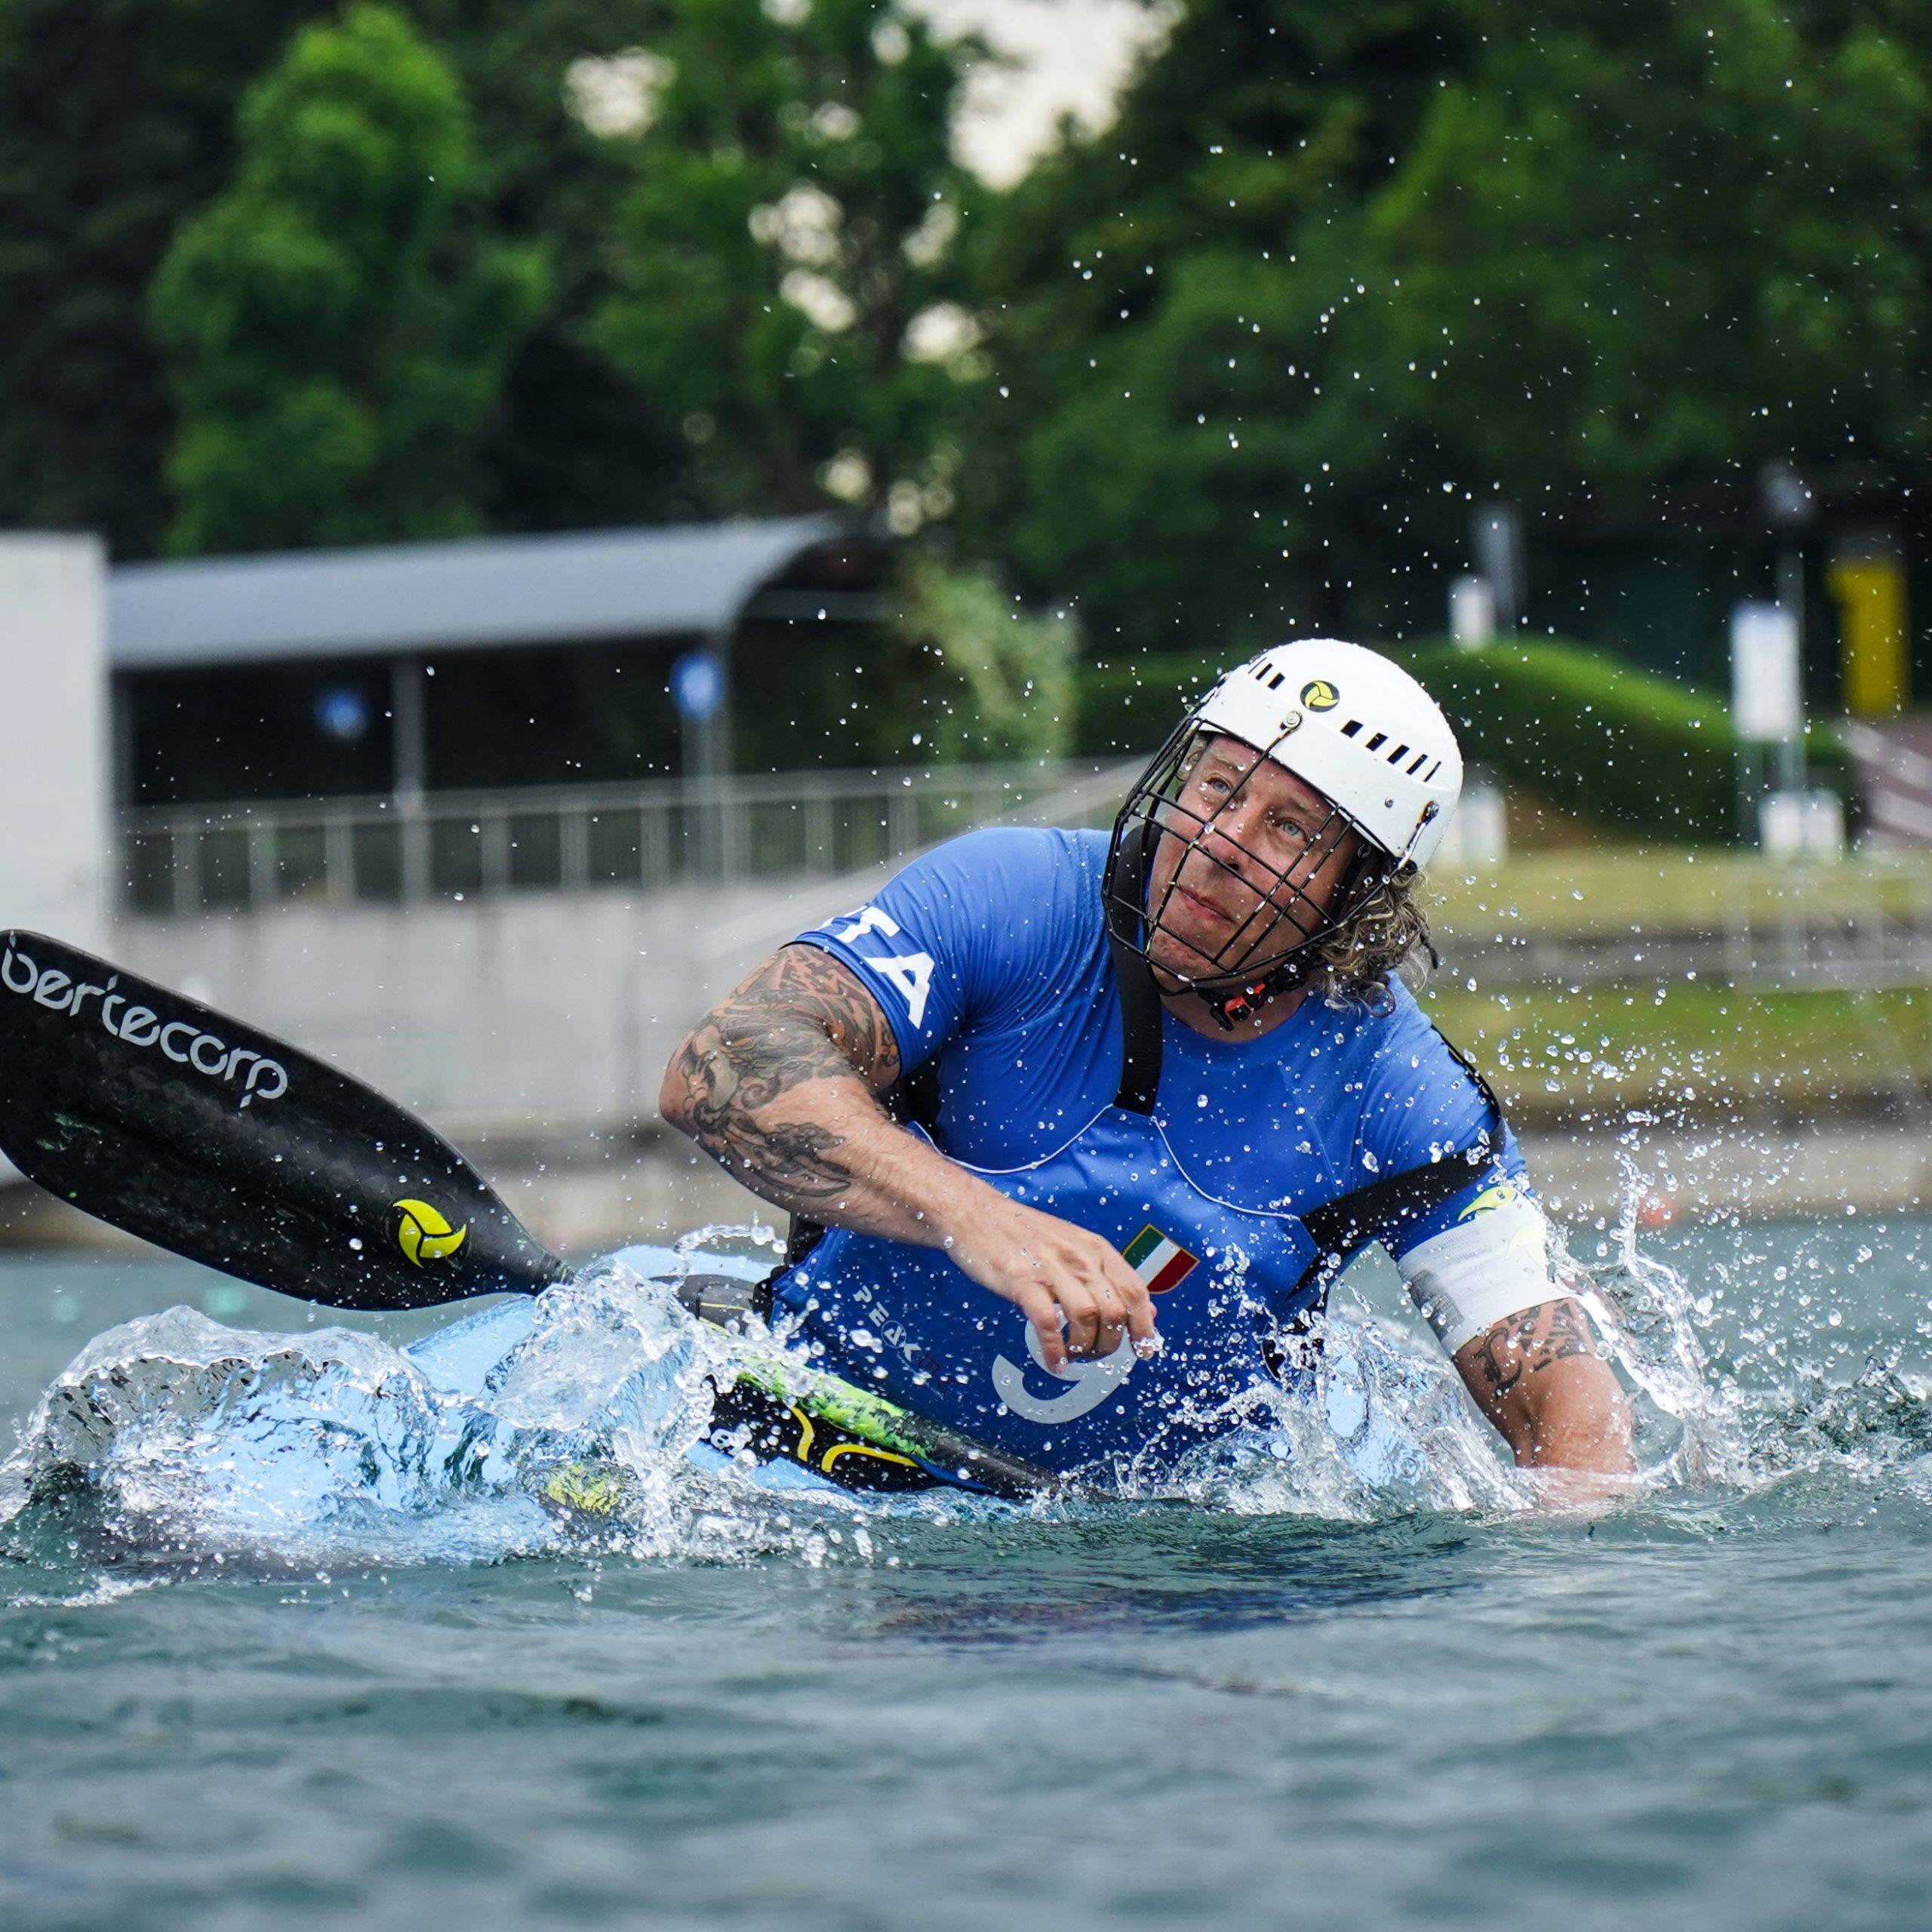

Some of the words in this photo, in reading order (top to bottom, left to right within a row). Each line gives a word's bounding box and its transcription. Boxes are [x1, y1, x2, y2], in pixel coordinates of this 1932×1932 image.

[1, 930, 288, 1109] bertecorp
[814, 905, 935, 1029] TA
[852, 1284, 922, 1362] PEAK
[991, 1303, 1138, 1424] 9
